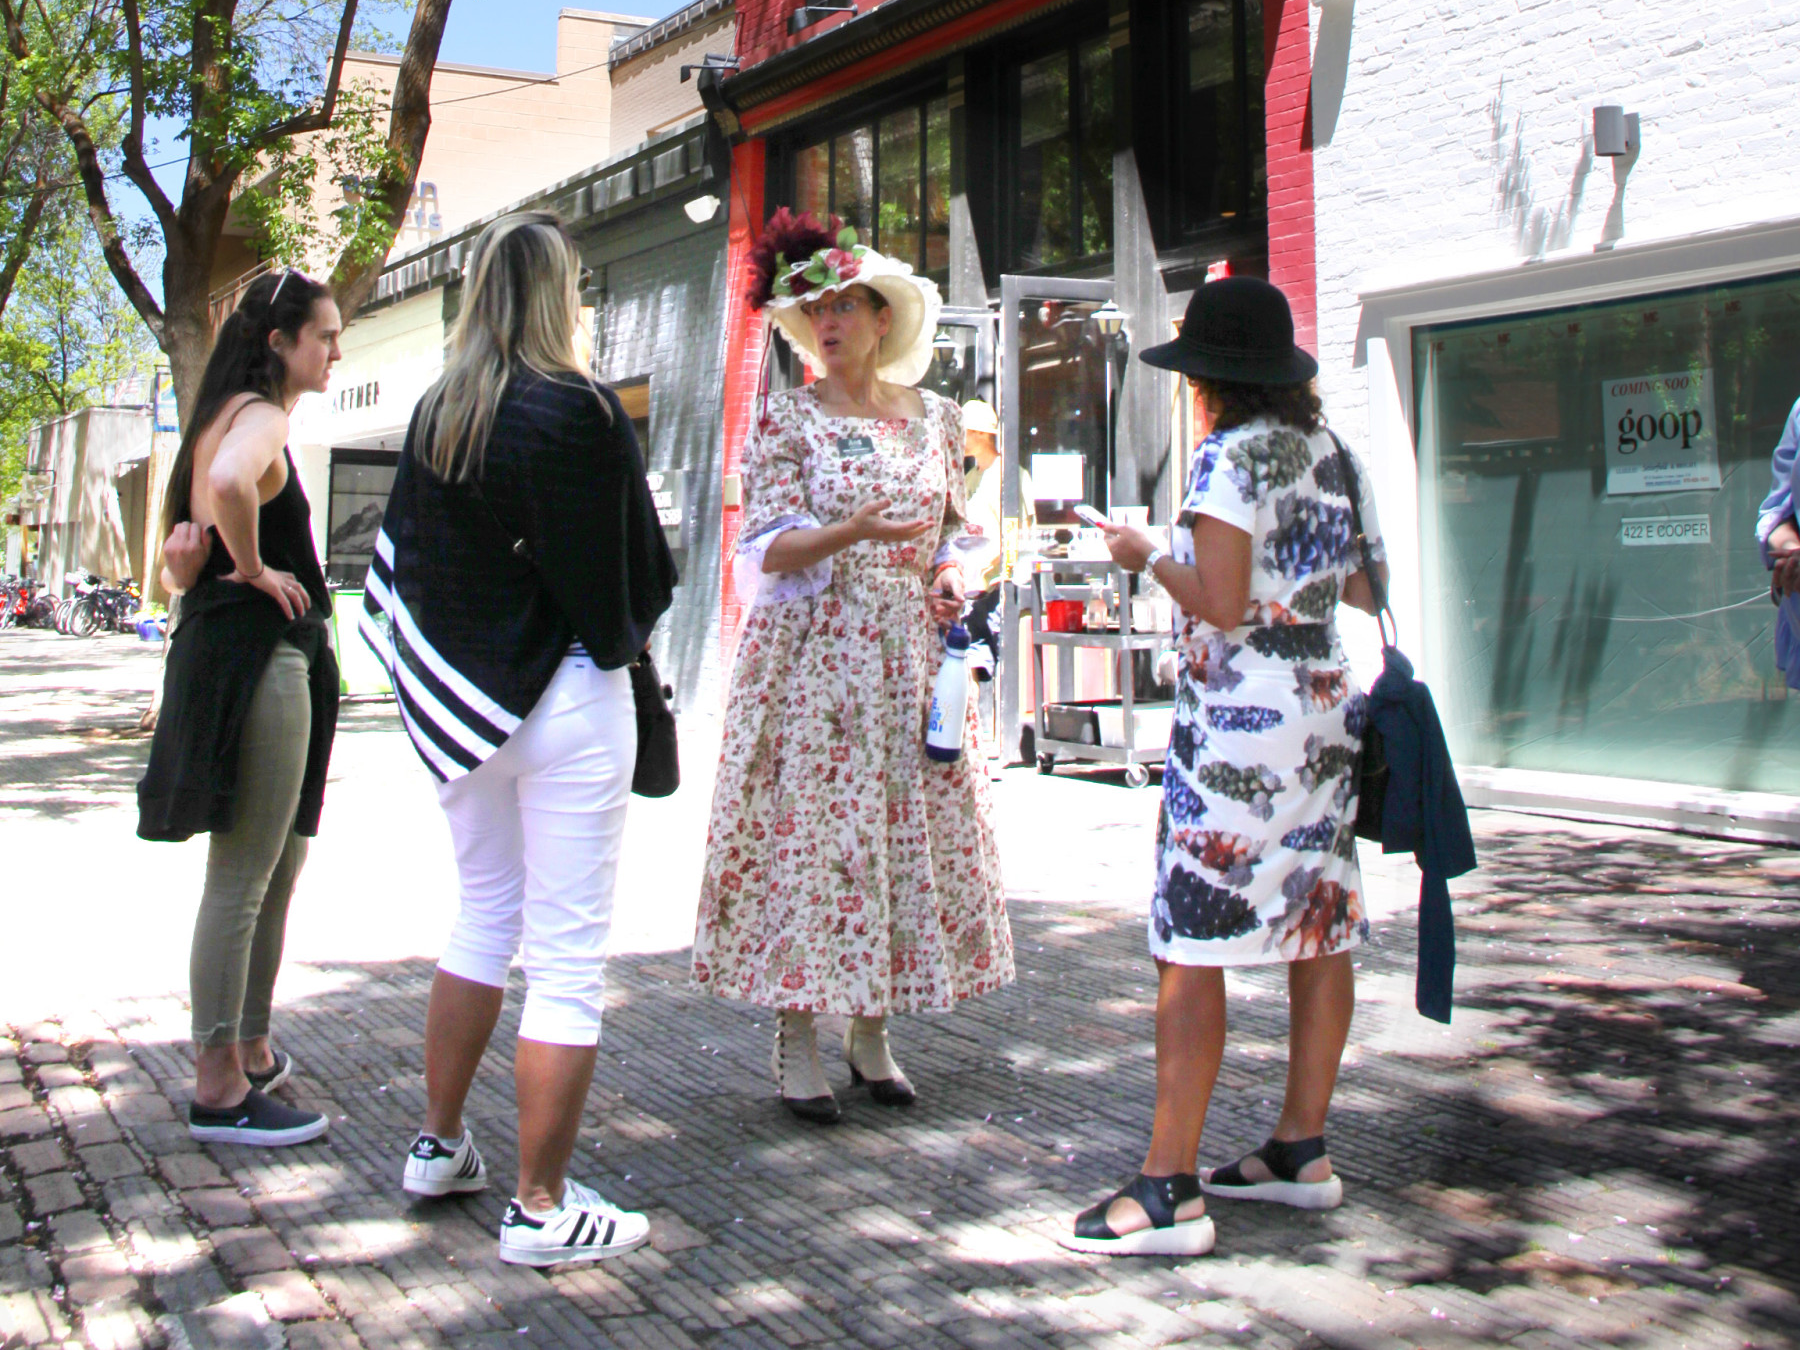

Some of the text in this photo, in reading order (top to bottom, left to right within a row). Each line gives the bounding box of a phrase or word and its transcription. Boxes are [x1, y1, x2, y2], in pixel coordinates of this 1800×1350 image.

[1611, 378, 1661, 398] COMING
[1617, 408, 1703, 454] goop
[1623, 522, 1709, 539] 422 E COOPER
